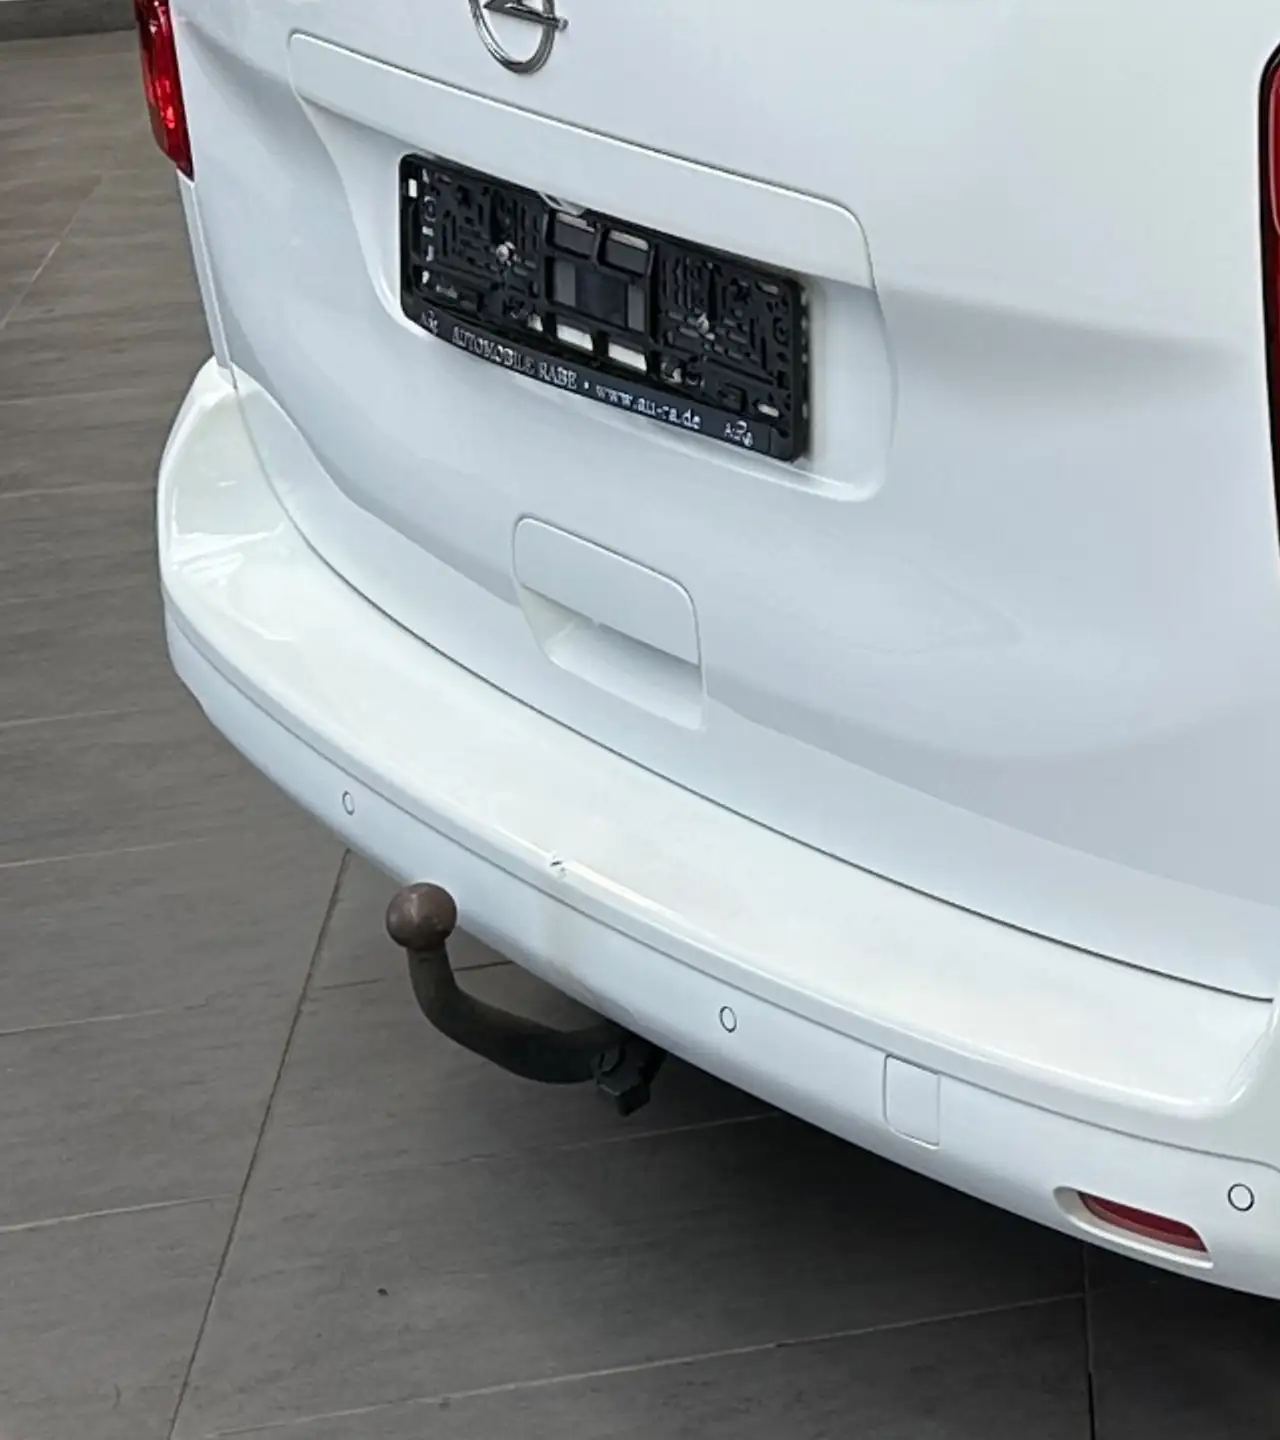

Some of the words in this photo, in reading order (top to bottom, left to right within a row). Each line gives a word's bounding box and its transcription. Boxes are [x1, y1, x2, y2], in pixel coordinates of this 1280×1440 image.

[452, 326, 535, 376] AUTOMOBILE
[539, 361, 577, 389] RABE
[596, 385, 700, 429] www.au-ra.de
